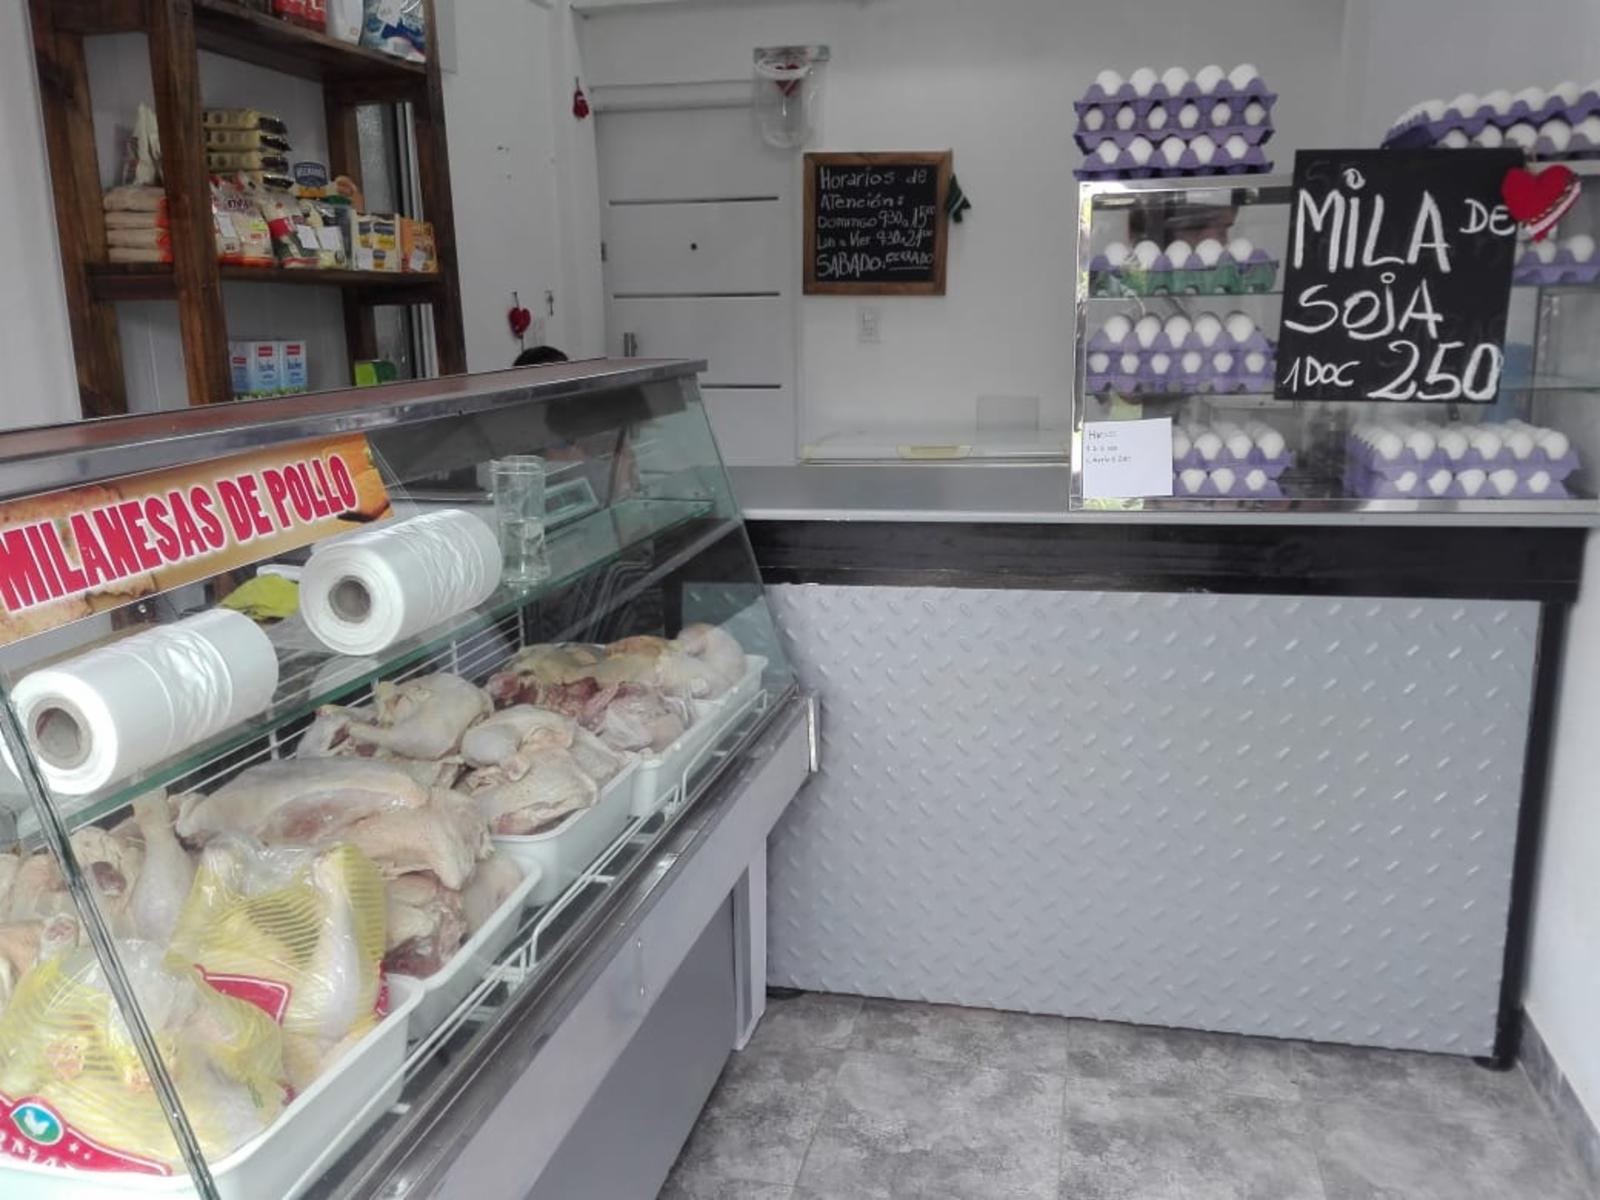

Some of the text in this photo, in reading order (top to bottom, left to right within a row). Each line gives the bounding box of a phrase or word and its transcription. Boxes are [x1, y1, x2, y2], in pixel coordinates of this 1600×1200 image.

[820, 166, 895, 190] Horarios
[1459, 198, 1515, 236] DE
[1366, 339, 1502, 401] 250
[0, 454, 357, 612] MILANESAS DE POLLO
